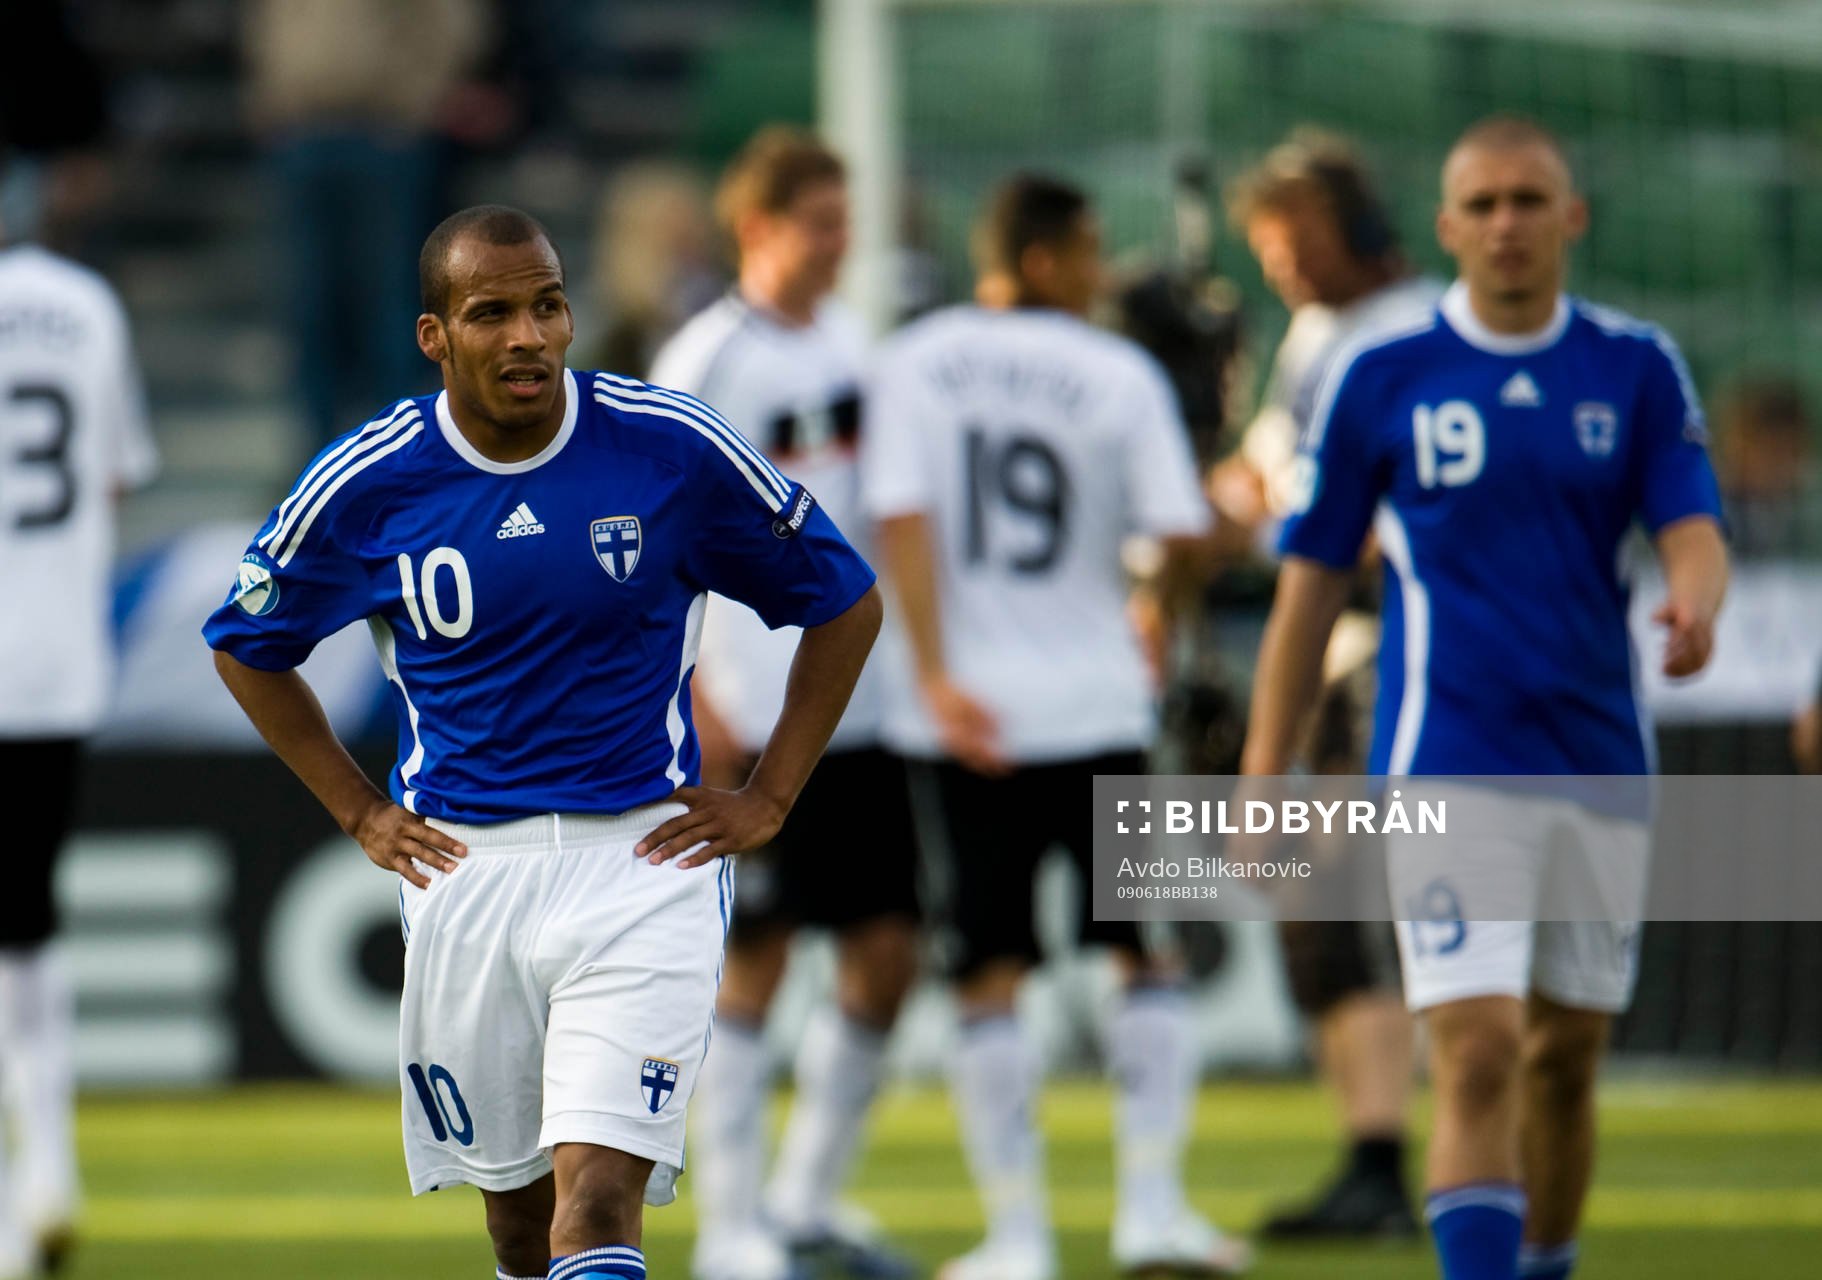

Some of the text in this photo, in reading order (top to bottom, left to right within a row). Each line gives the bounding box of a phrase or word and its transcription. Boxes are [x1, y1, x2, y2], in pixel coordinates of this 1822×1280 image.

[1412, 400, 1486, 489] 19
[496, 523, 546, 540] adidas
[787, 491, 813, 530] RESPECT
[960, 424, 1074, 577] 19
[397, 546, 474, 641] 10
[1405, 877, 1467, 962] 19
[407, 1063, 474, 1147] 10
